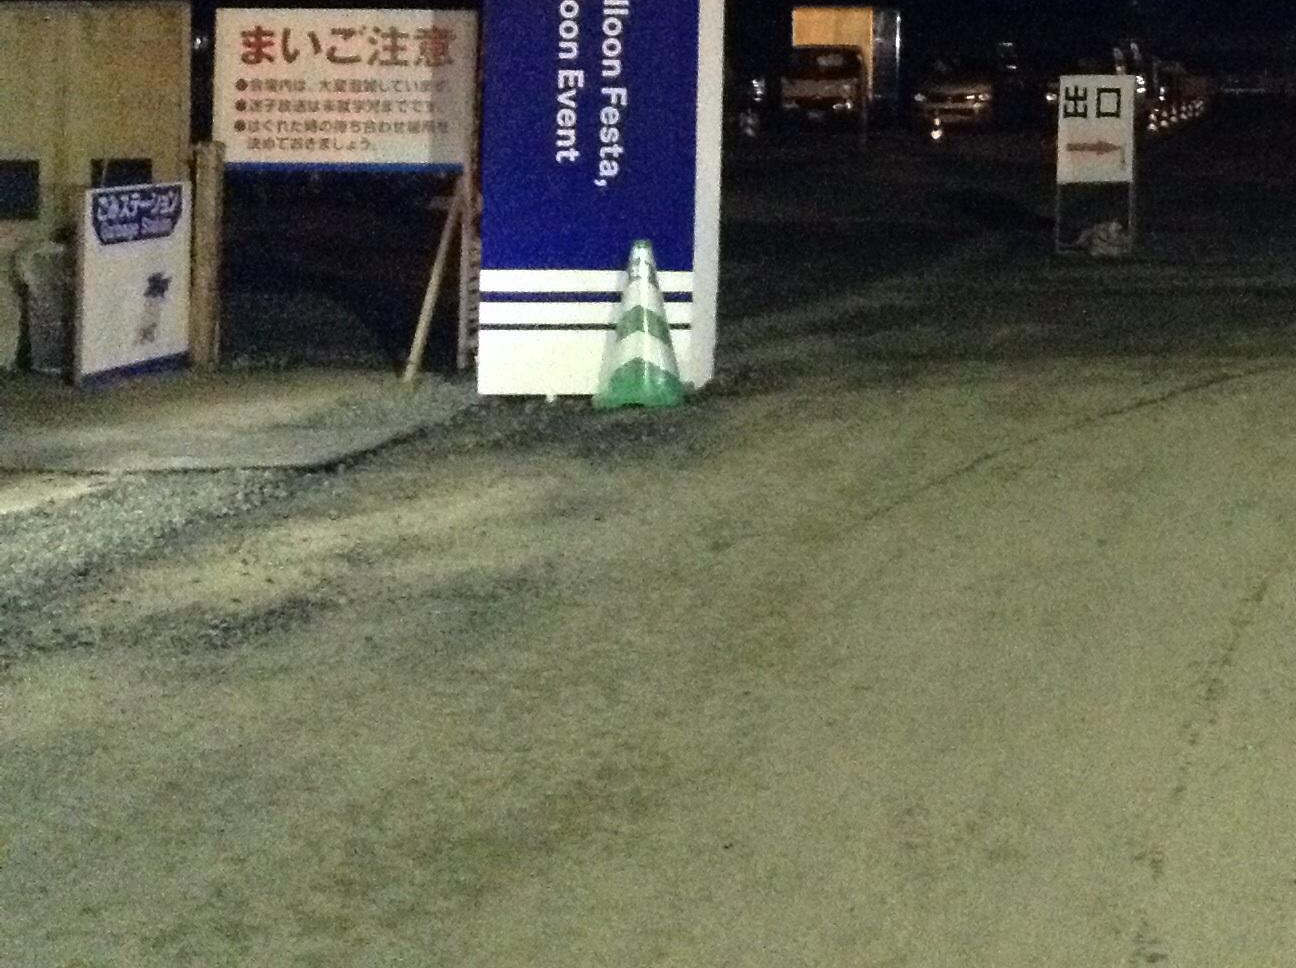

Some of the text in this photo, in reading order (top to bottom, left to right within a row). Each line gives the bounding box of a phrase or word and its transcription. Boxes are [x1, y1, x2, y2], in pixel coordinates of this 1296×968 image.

[240, 25, 457, 67] まいご注意
[555, 70, 585, 164] Event
[1063, 85, 1122, 119] 出口
[594, 87, 628, 187] Festa,
